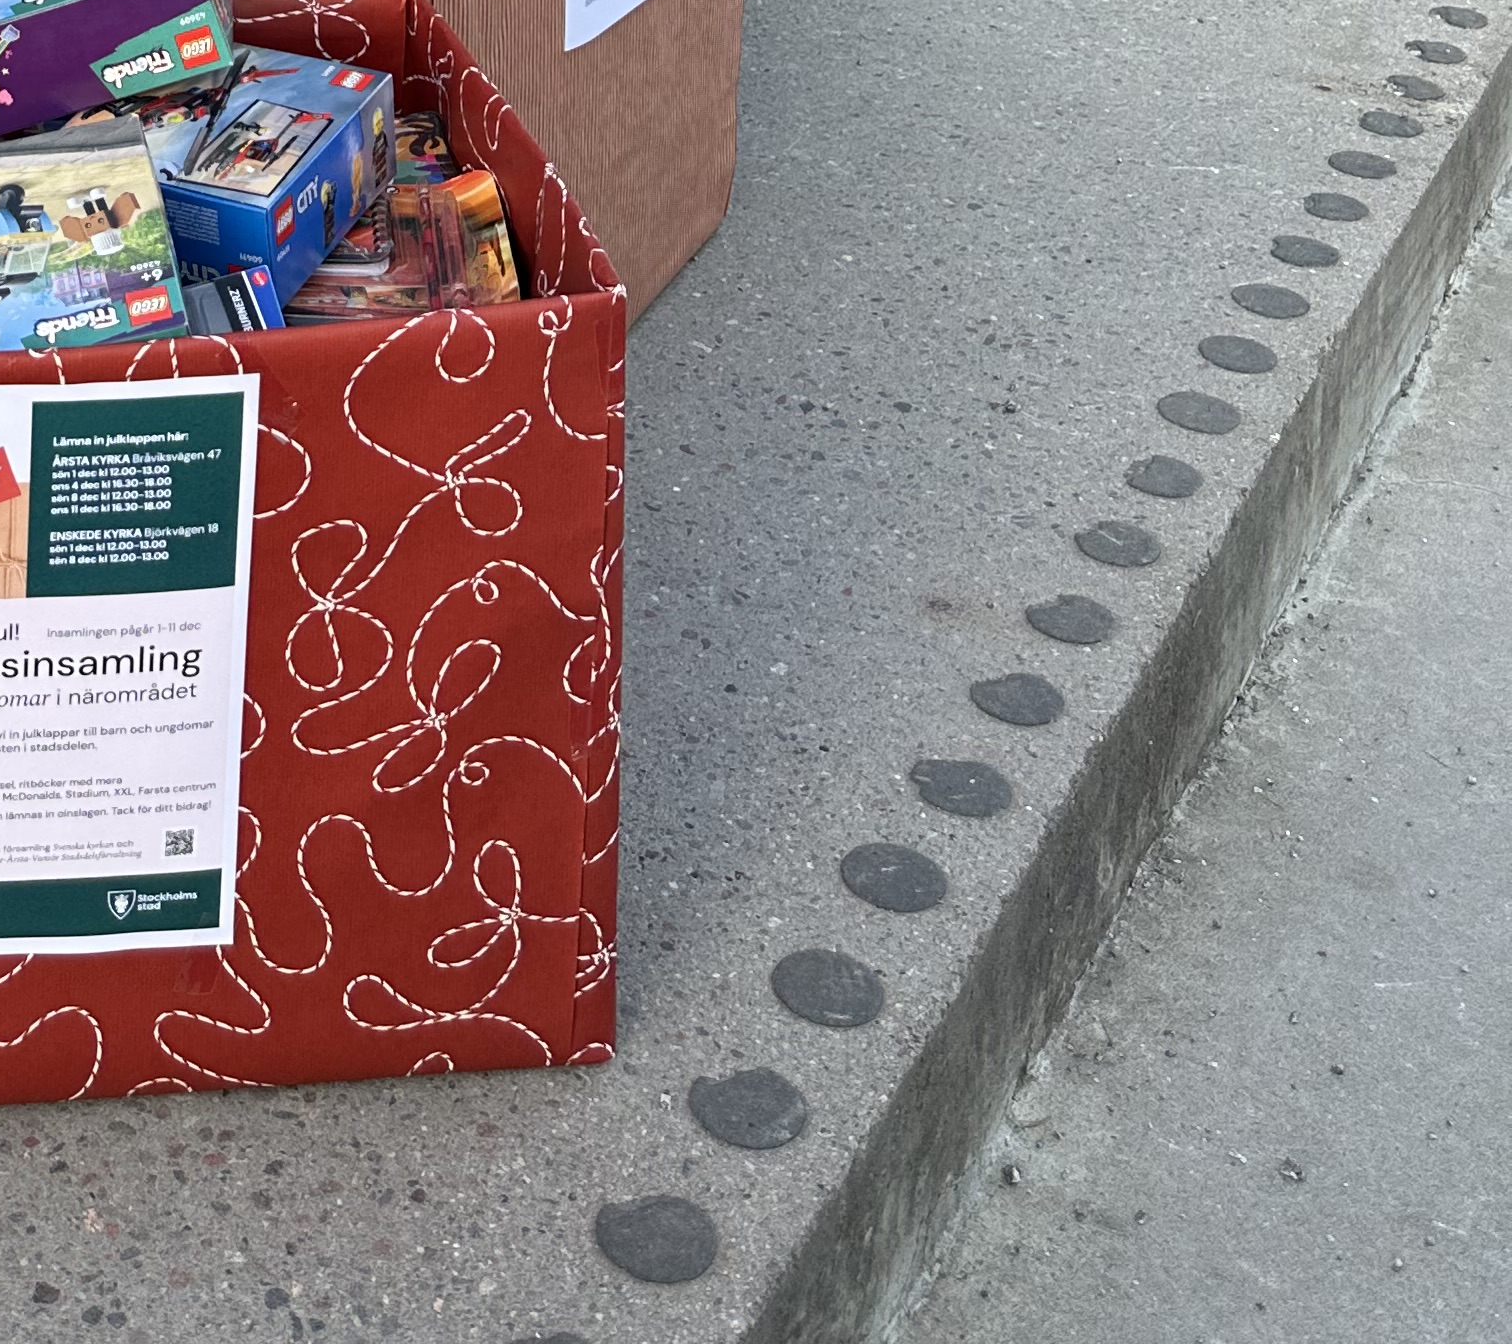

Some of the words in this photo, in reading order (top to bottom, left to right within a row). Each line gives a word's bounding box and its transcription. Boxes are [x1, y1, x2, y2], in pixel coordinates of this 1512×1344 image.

[180, 34, 215, 60] LEGO
[102, 48, 175, 88] Friends
[296, 175, 320, 215] CITY
[141, 269, 163, 281] 6+
[128, 293, 170, 317] LEGO
[35, 305, 120, 344] Friends
[53, 436, 91, 446] Lämna
[93, 435, 104, 444] in
[105, 434, 165, 446] julklappen
[52, 454, 89, 466] ÅRSTA
[91, 454, 130, 464] KYRKA
[132, 452, 204, 463] Bråviksvägen
[206, 448, 221, 458] 47
[49, 530, 101, 541] ENSKEDE
[103, 528, 142, 538] KYRKA
[144, 526, 204, 538] Björkvägen
[208, 523, 218, 532] 18
[69, 683, 196, 704] närområdet
[8, 730, 19, 738] in
[21, 728, 80, 741] julklappar
[83, 726, 97, 735] till
[100, 726, 127, 735] barn
[129, 724, 152, 733] och
[154, 720, 214, 733] ungdomar
[137, 891, 197, 902] Stockholms
[137, 901, 161, 910] stad
